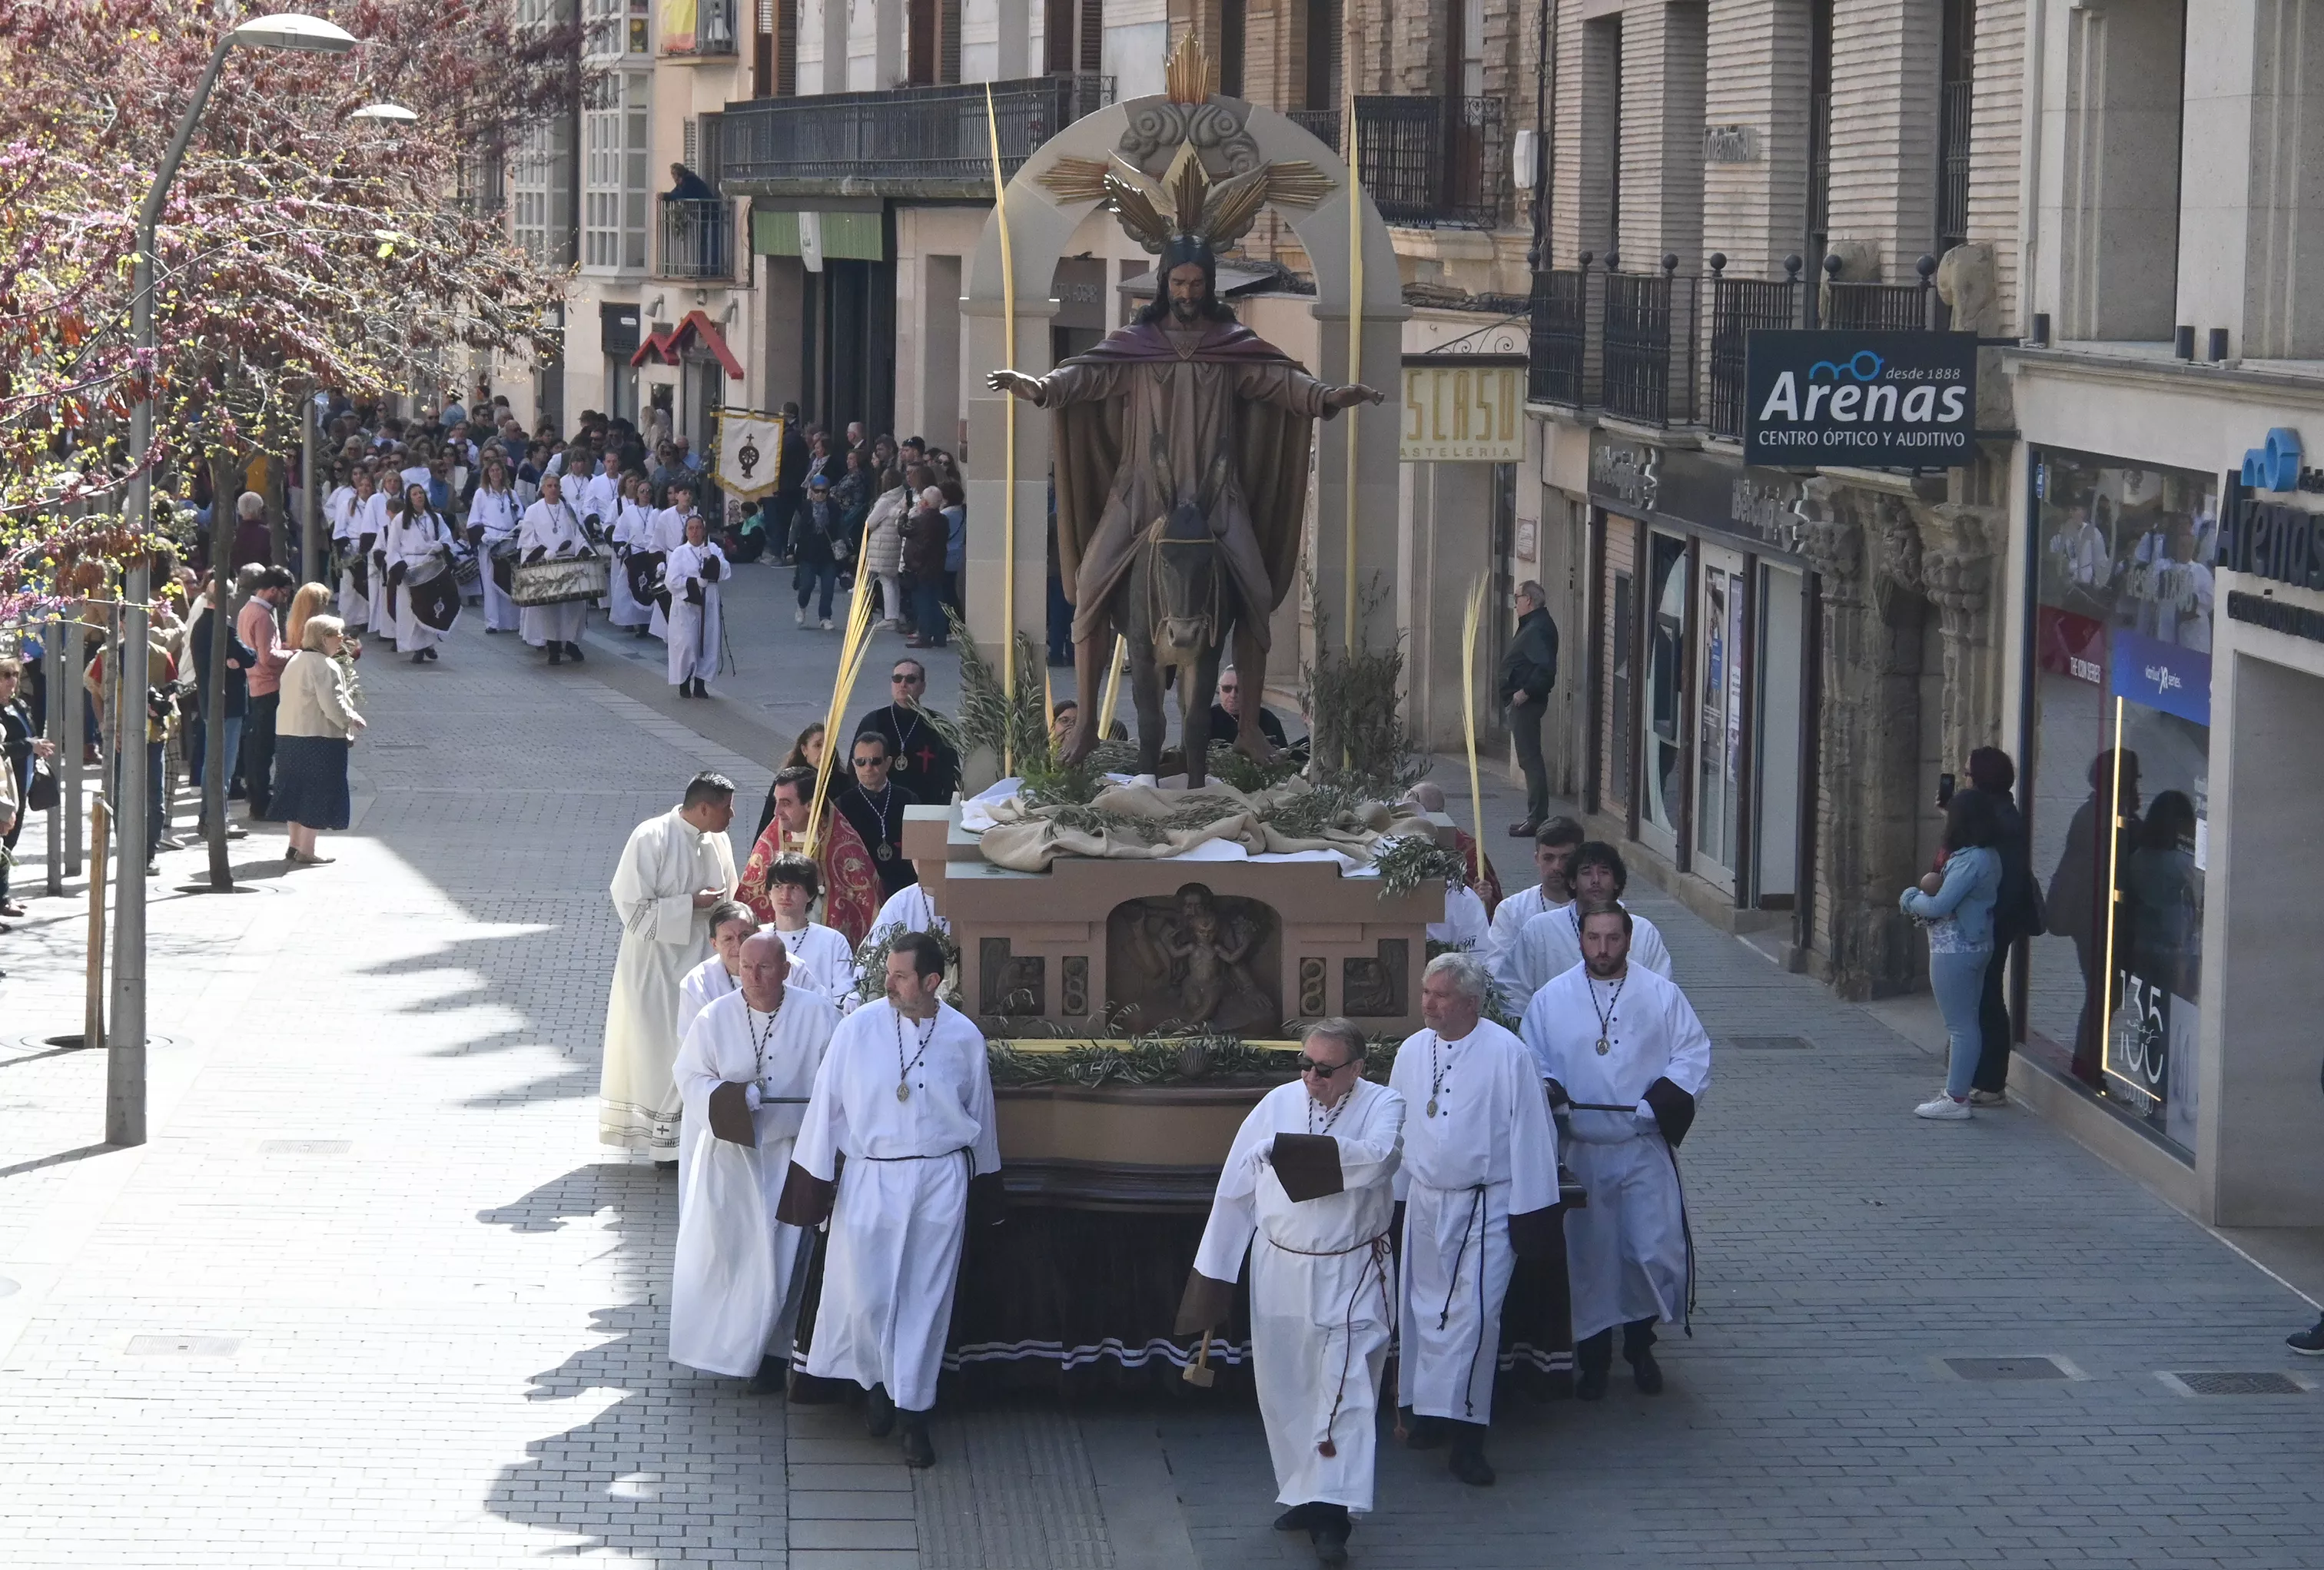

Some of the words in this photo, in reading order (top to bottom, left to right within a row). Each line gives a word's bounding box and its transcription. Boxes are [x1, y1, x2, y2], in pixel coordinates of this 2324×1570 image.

[1885, 367, 1924, 380] desde
[1927, 368, 1960, 380] 1888
[1406, 370, 1514, 441] SCASO
[1758, 370, 1967, 423] Arenas
[1758, 430, 1818, 446] CENTRO
[1823, 427, 1878, 446] ÓPTICO
[1883, 431, 1893, 446] Y
[1896, 432, 1965, 447] AUDITIVO
[1400, 446, 1511, 457] ASTELERIA
